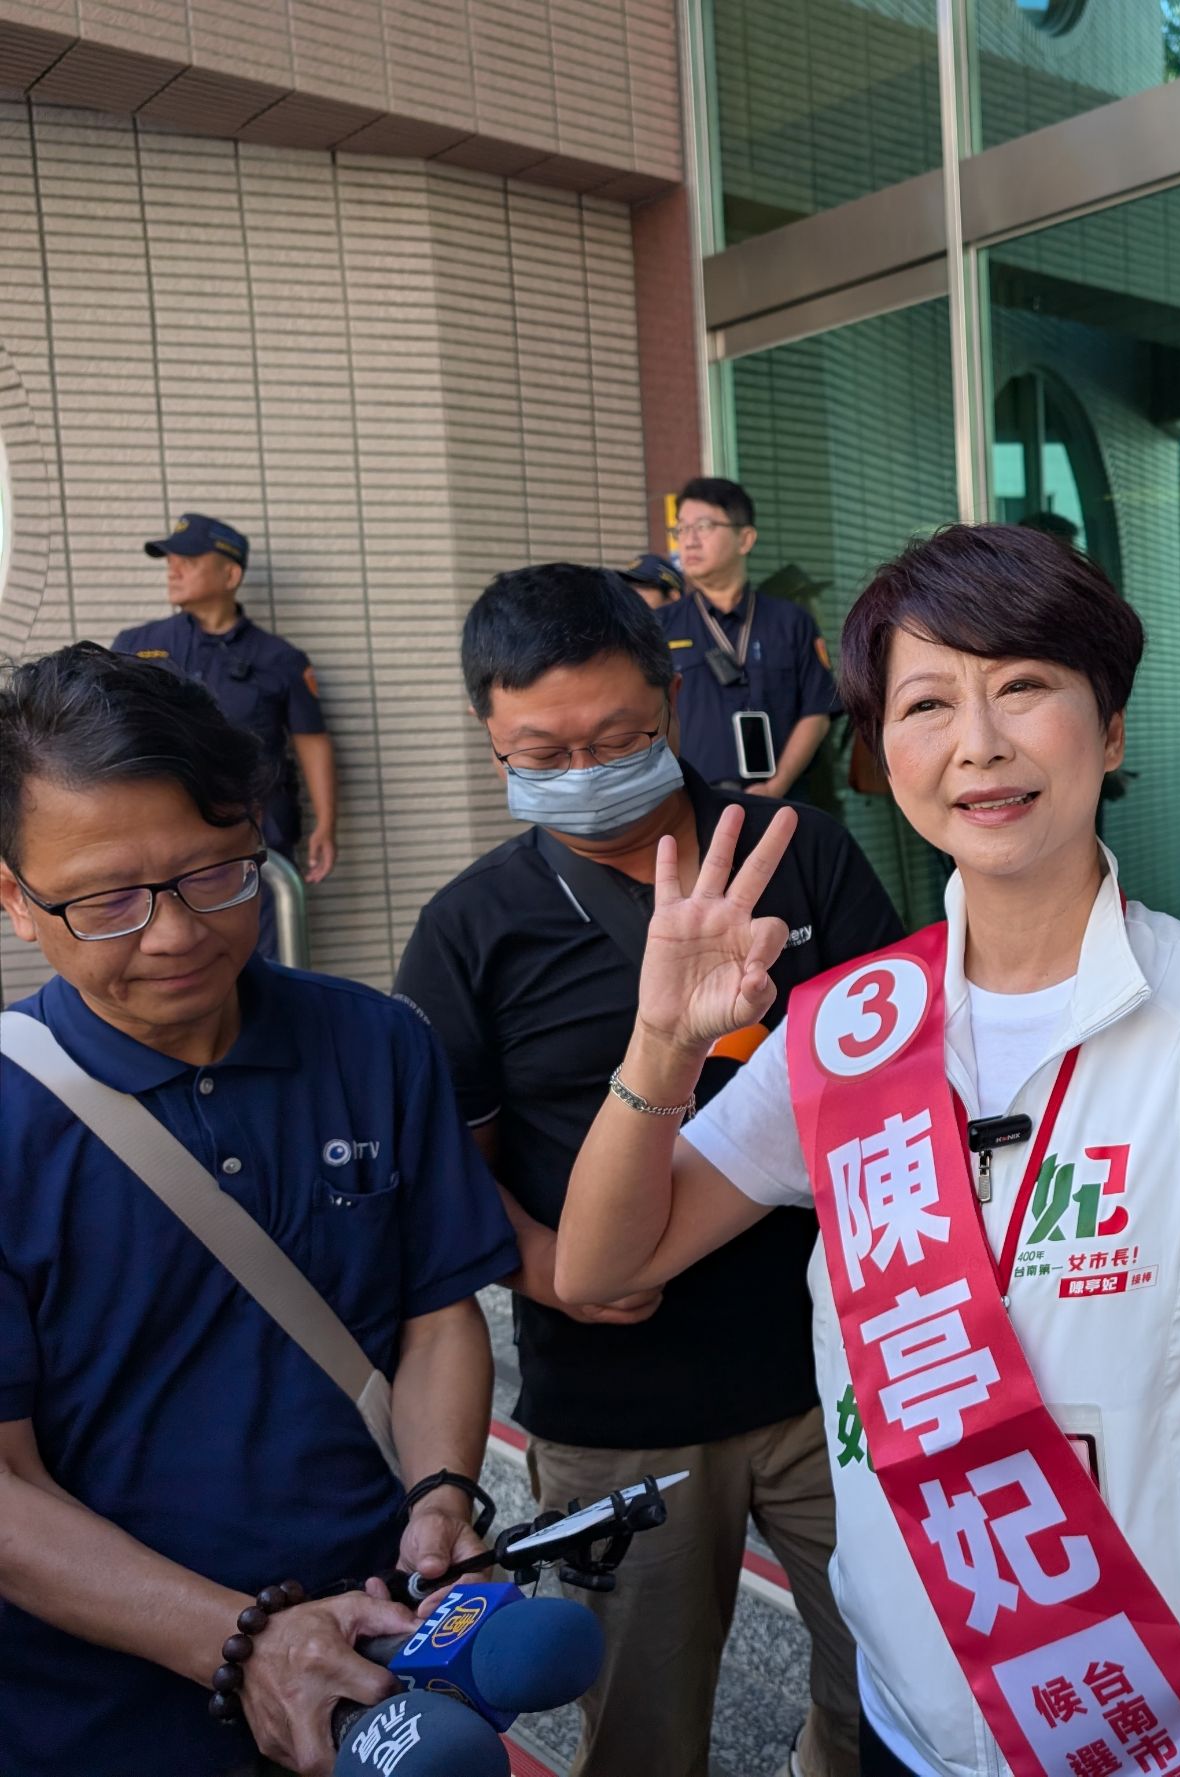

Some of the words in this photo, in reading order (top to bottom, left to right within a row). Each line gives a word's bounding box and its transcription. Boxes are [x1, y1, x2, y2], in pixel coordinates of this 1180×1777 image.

[838, 969, 899, 1059] 3
[1018, 1250, 1045, 1262] 400年
[1069, 1277, 1118, 1294] 陳亭妃
[827, 1107, 1101, 1637] 陳亭妃
[403, 1592, 463, 1657] NTD
[351, 1700, 422, 1777] 民視
